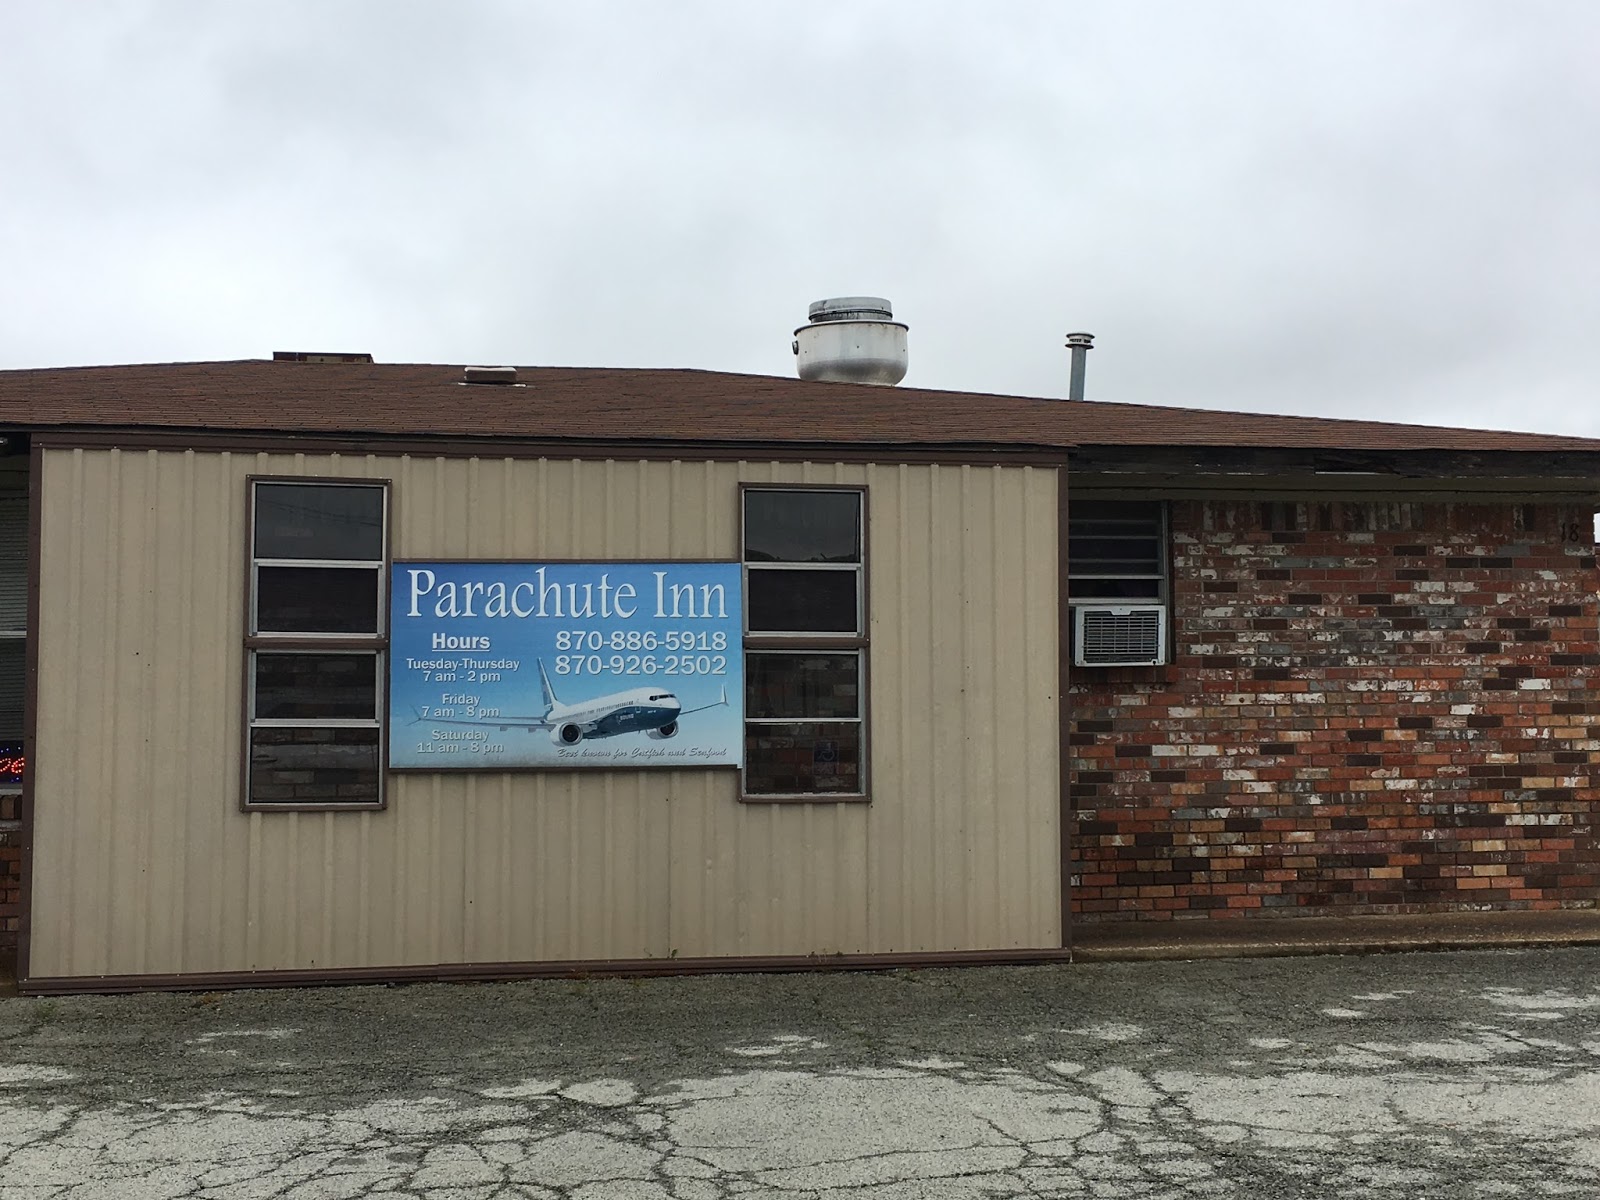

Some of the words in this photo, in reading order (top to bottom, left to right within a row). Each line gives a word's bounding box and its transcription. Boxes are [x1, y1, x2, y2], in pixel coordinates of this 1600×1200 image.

[407, 567, 638, 619] Parachute
[653, 571, 729, 619] Inn
[432, 632, 491, 652] Hours
[555, 631, 728, 652] 870-886-5918
[406, 658, 520, 671] Tuesday-Thursday
[555, 655, 728, 676] 870-926-2502
[423, 671, 431, 682] 7
[435, 672, 457, 682] am
[467, 671, 476, 682] 2
[480, 672, 501, 684] pm
[442, 694, 481, 707] Friday
[422, 706, 430, 717] 7
[434, 707, 455, 717] am
[466, 706, 475, 717] 8
[479, 708, 500, 719] pm
[432, 730, 489, 742] Saturday
[417, 742, 435, 753] 11
[438, 743, 459, 753] am
[470, 742, 480, 753] 8
[483, 744, 504, 755] pm
[612, 748, 628, 759] for
[668, 748, 687, 757] and
[689, 747, 727, 758] Seafood
